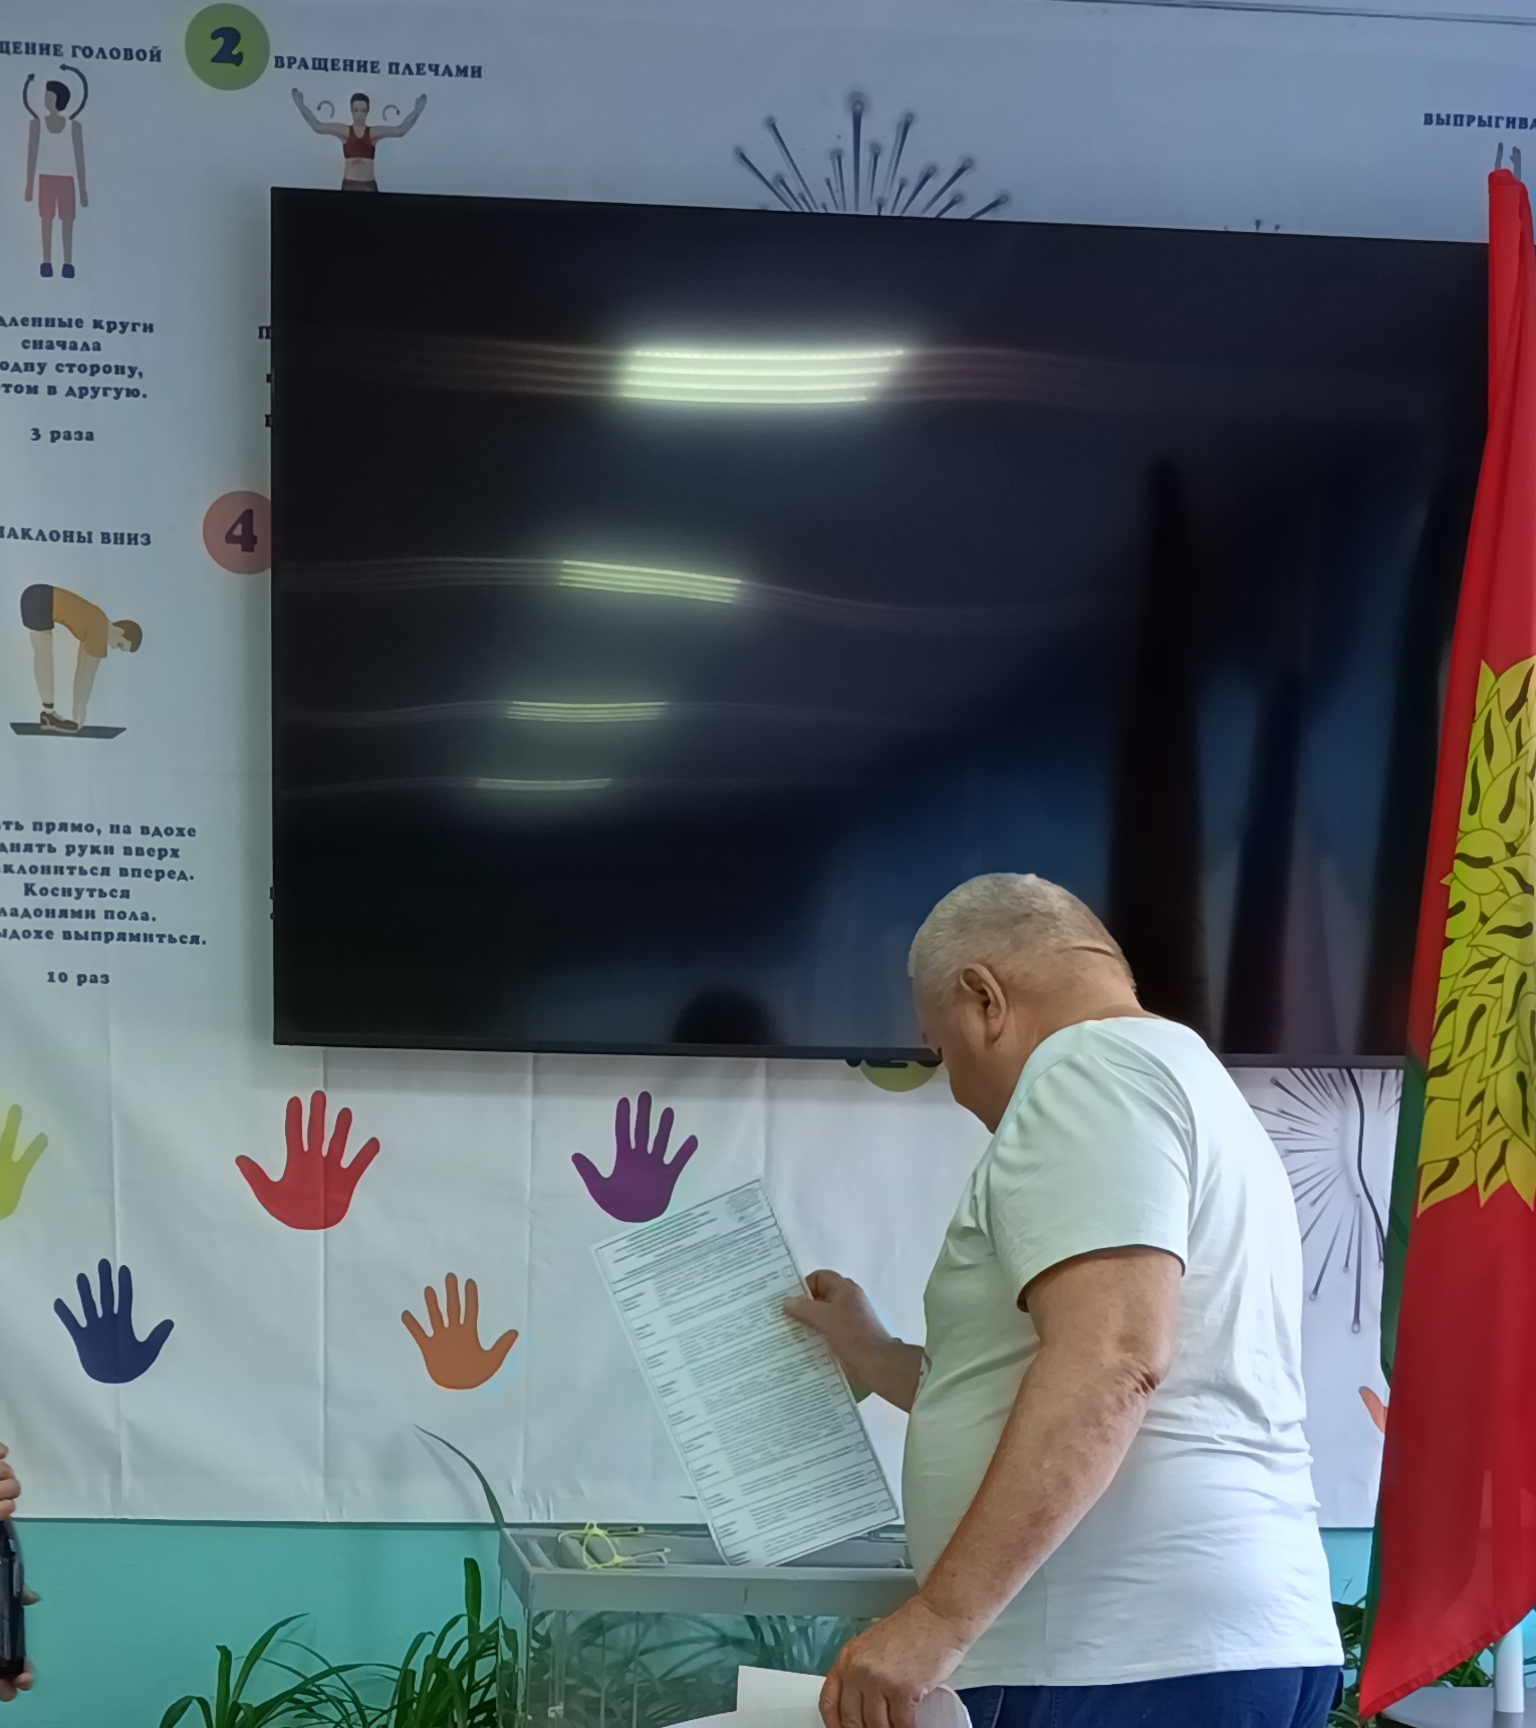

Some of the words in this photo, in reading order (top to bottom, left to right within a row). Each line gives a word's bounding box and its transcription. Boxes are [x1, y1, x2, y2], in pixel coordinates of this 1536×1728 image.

[71, 44, 162, 62] ГОЛОВОЙ
[210, 26, 244, 67] 2
[274, 55, 381, 74] ВРАЩЕНИЕ
[388, 61, 483, 79] ПЛЕЧАМИ
[92, 317, 154, 335] круги
[21, 338, 102, 352] сначала
[55, 362, 143, 379] сторону,
[46, 384, 58, 396] в
[64, 385, 148, 400] другую.
[30, 427, 42, 442] 3
[49, 429, 95, 444] раза
[100, 531, 152, 547] ВНИЗ
[224, 509, 258, 554] 4
[32, 820, 102, 836] прямо,
[108, 822, 132, 835] на
[140, 825, 197, 838] вдохе
[64, 842, 115, 857] руки
[122, 844, 180, 861] вверх
[118, 866, 195, 882] вперед.
[23, 882, 131, 900] Коснуться
[103, 908, 157, 922] пола.
[62, 929, 207, 946] выпрямиться.
[47, 971, 68, 984] 10
[76, 972, 110, 987] раз
